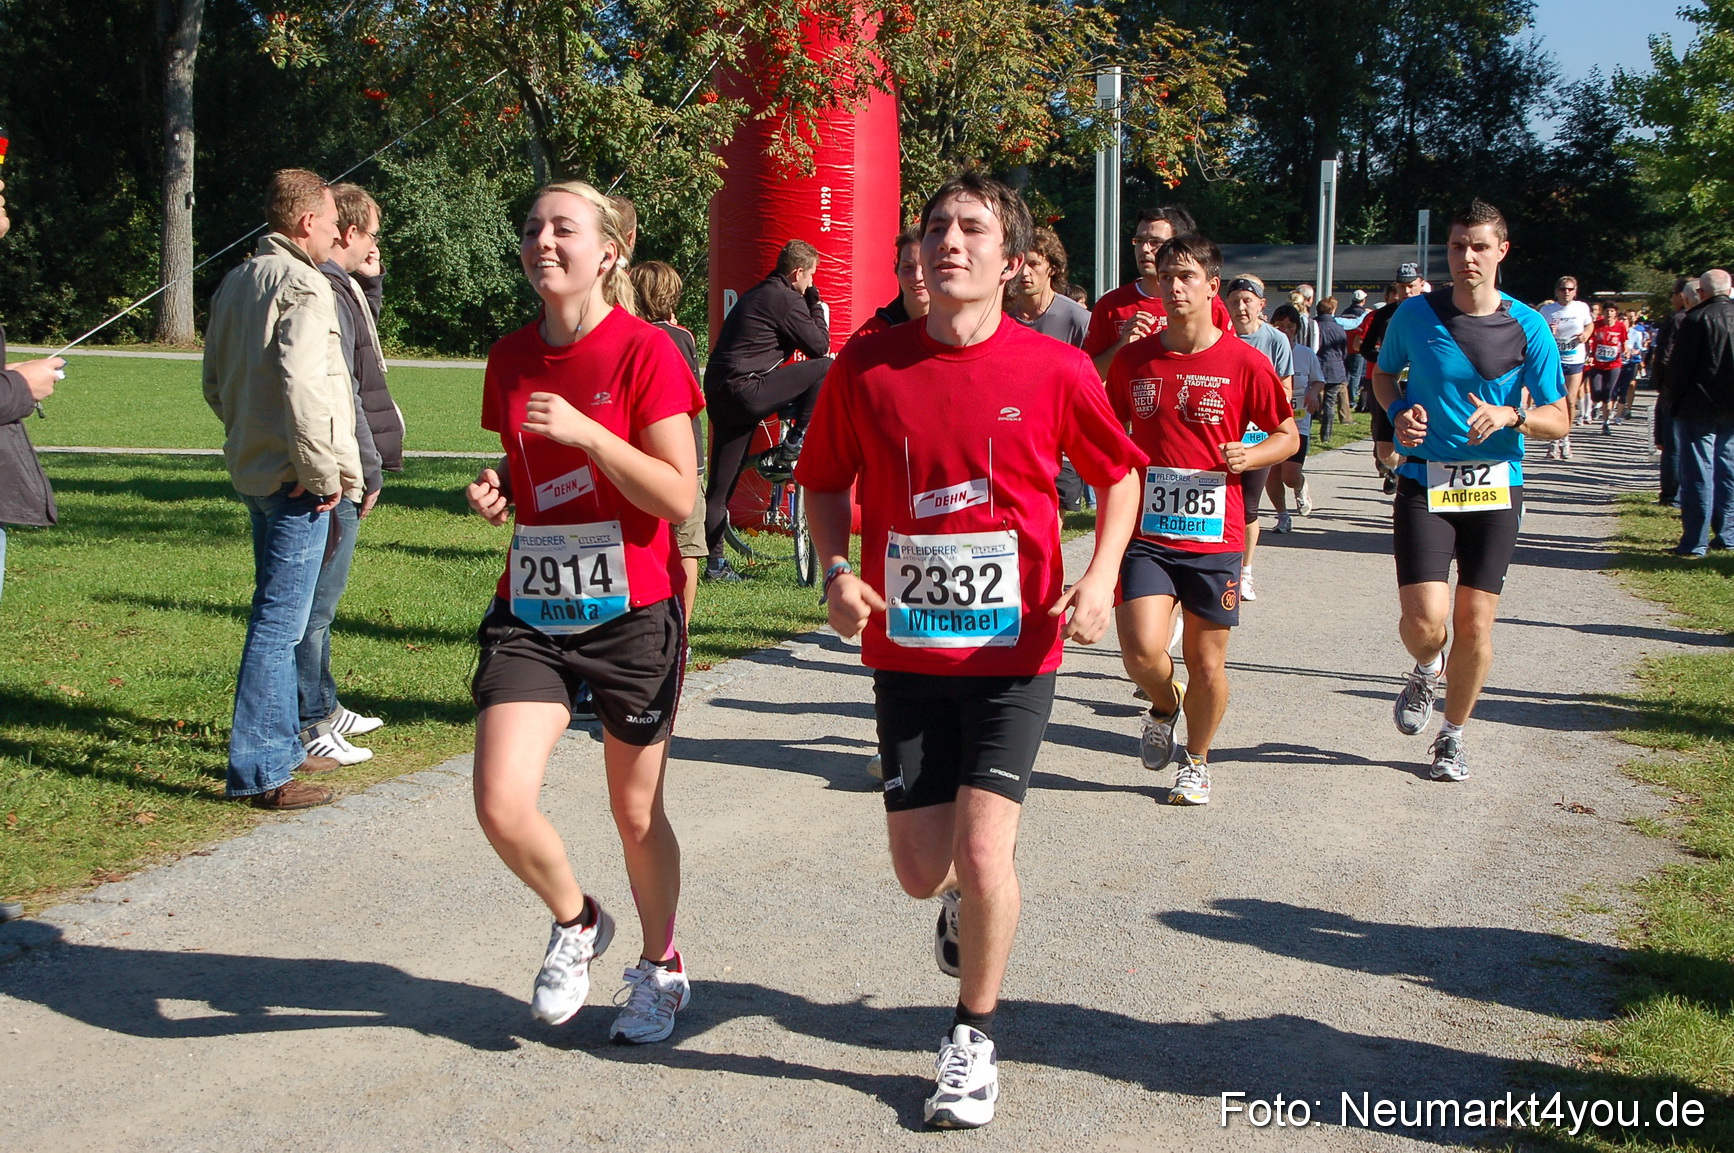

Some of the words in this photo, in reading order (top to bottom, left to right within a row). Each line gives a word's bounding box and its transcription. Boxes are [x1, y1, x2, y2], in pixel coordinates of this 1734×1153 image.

[820, 186, 831, 210] 1929
[820, 213, 831, 232] Seit
[1133, 383, 1156, 391] IMMER
[1184, 380, 1221, 389] STADTLAUF
[1186, 375, 1230, 385] NEUMARKTER
[1134, 397, 1154, 406] NEU
[1156, 473, 1191, 482] PFLEIDERER
[1444, 464, 1491, 487] 752
[554, 479, 577, 497] DEHN
[1442, 489, 1497, 503] Andreas
[935, 490, 967, 508] DEHN
[1151, 486, 1216, 516] 3185
[1160, 516, 1206, 532] Robert
[901, 545, 957, 556] PFLEIDERER
[520, 553, 613, 596] 2914
[515, 588, 520, 596] C
[900, 563, 1004, 606] 2332
[909, 609, 998, 632] Michael
[626, 714, 653, 724] JAKO
